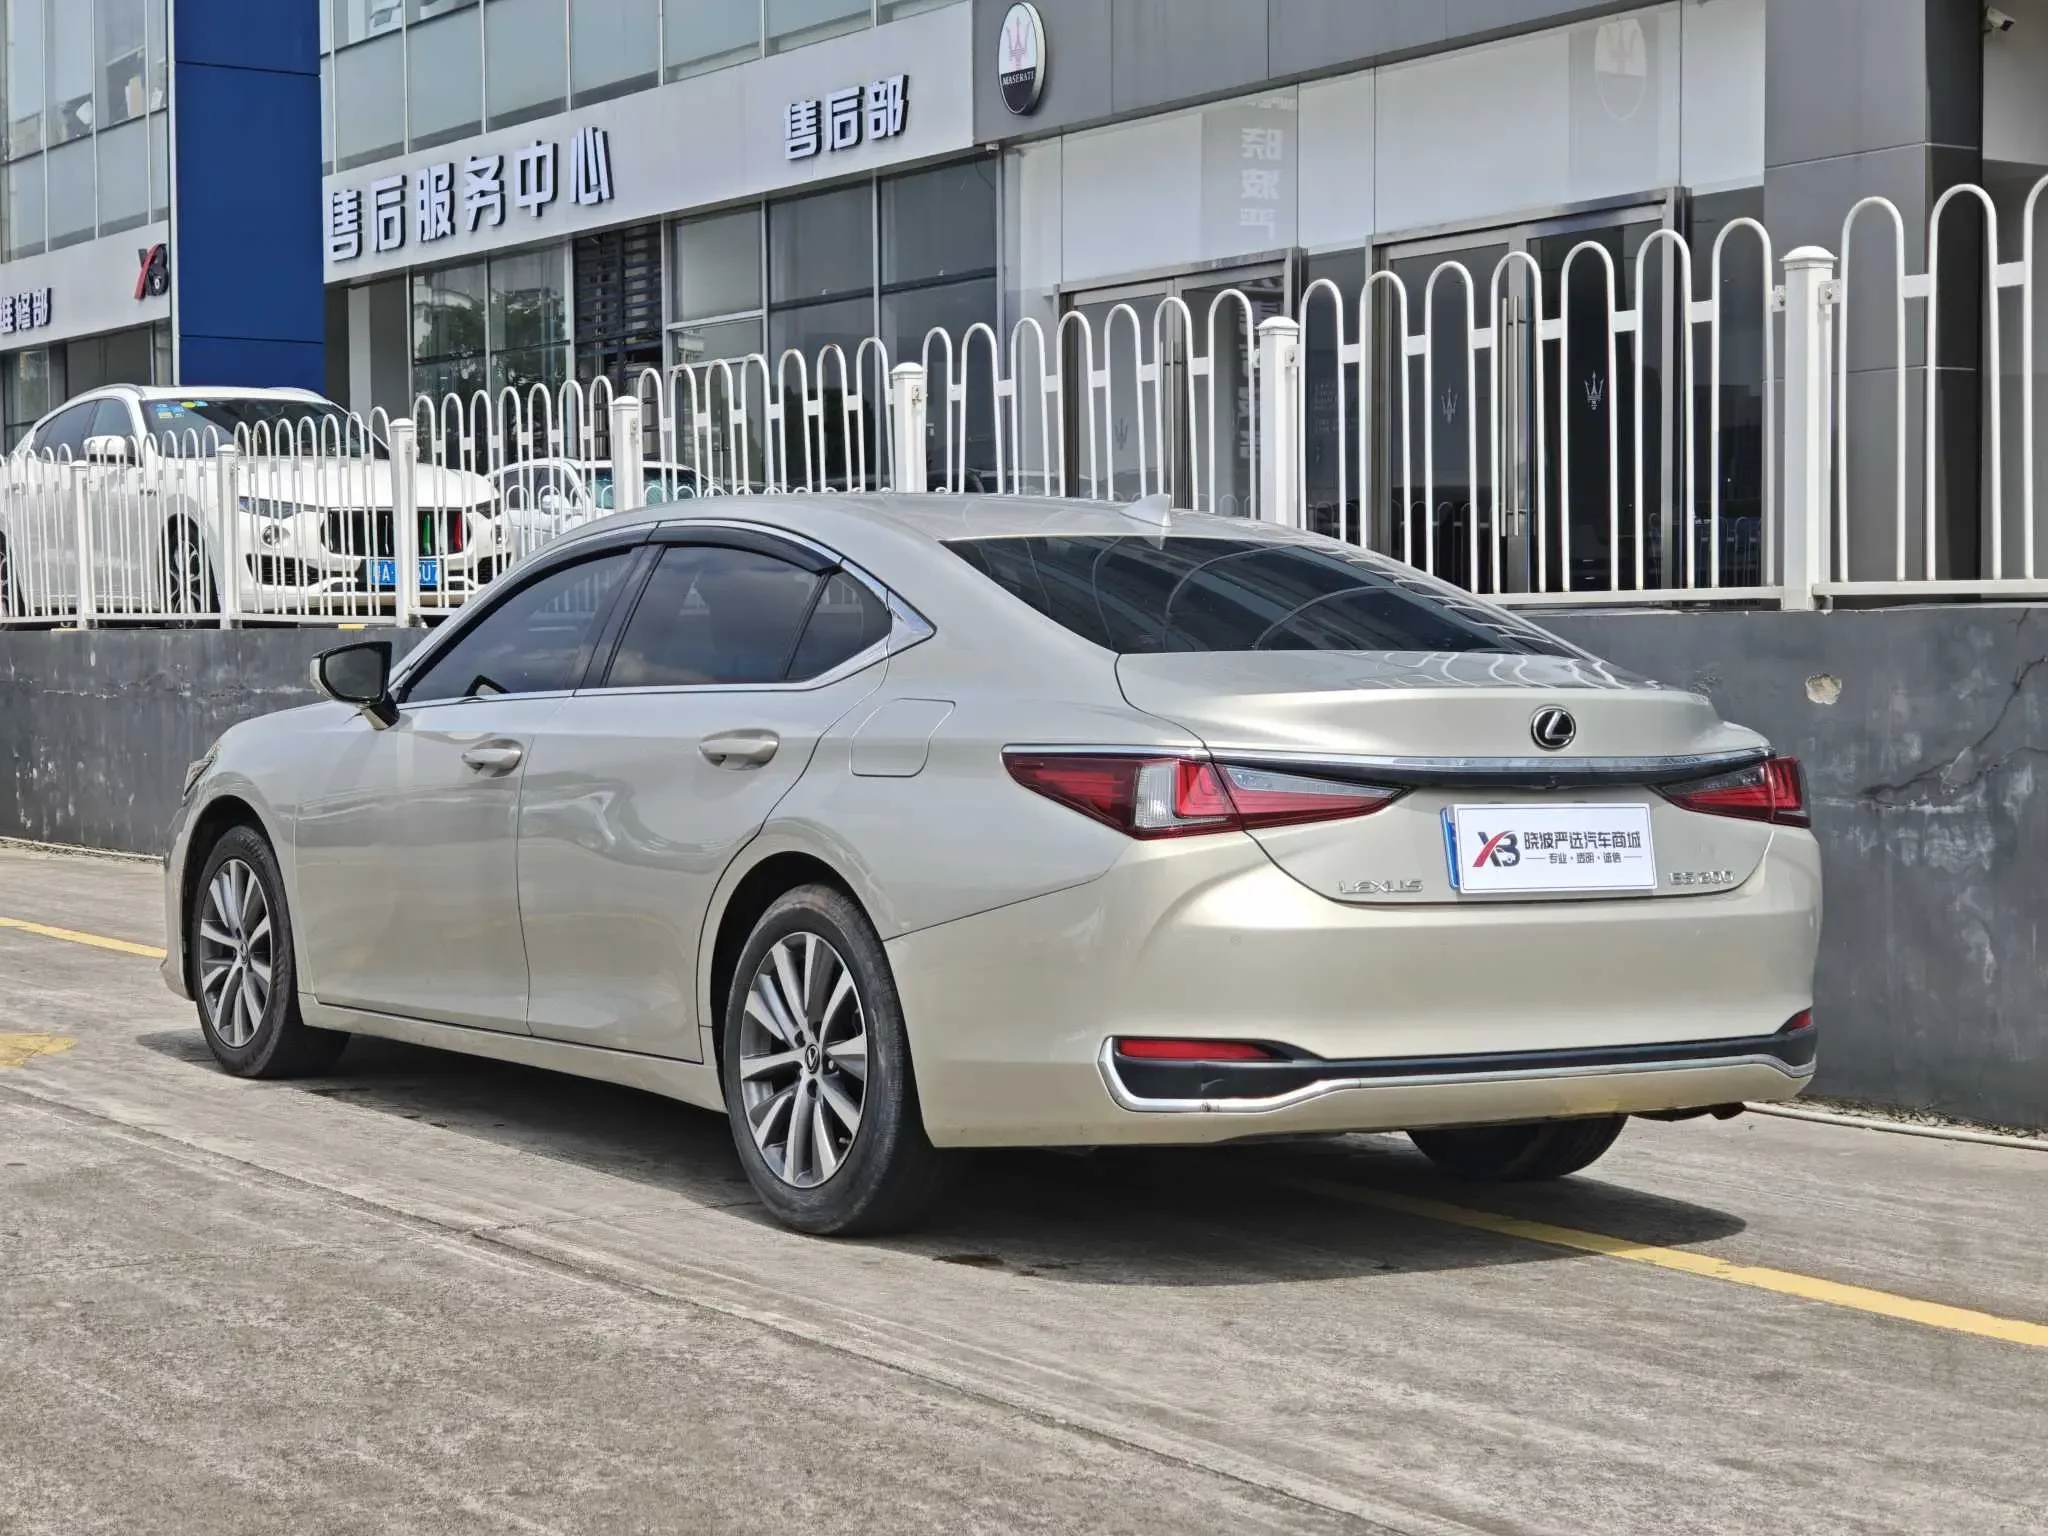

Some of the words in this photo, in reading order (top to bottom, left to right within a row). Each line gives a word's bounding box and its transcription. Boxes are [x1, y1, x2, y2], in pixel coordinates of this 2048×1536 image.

[1002, 70, 1035, 86] MASERATI
[784, 74, 909, 160] 售后部
[328, 126, 614, 262] 售后服务中心
[1524, 831, 1642, 850] 晓波严选汽车商城
[1339, 879, 1423, 893] LEXUS
